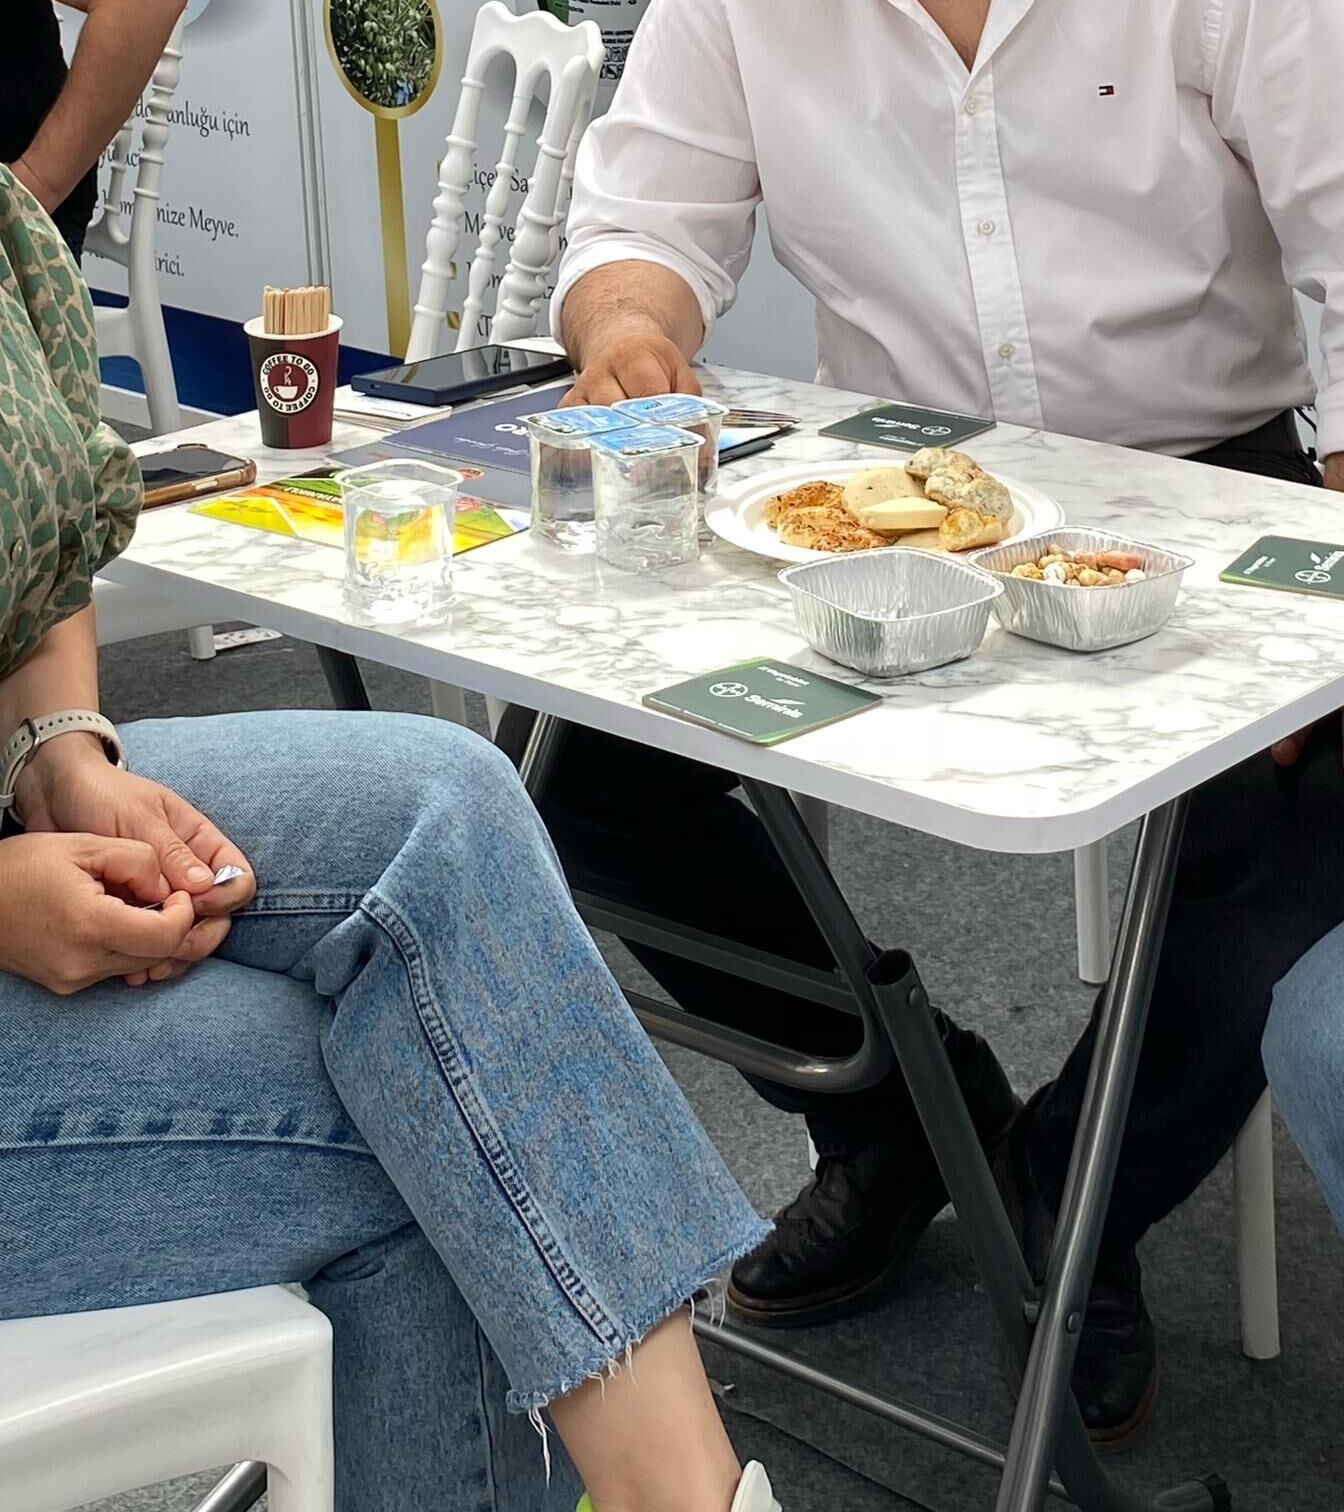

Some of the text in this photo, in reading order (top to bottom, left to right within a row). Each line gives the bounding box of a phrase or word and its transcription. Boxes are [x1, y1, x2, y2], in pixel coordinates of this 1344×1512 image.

[223, 111, 250, 140] için
[189, 206, 239, 241] Meyve.
[262, 355, 315, 376] COFFEE TO GO
[286, 386, 316, 412] COFFEE
